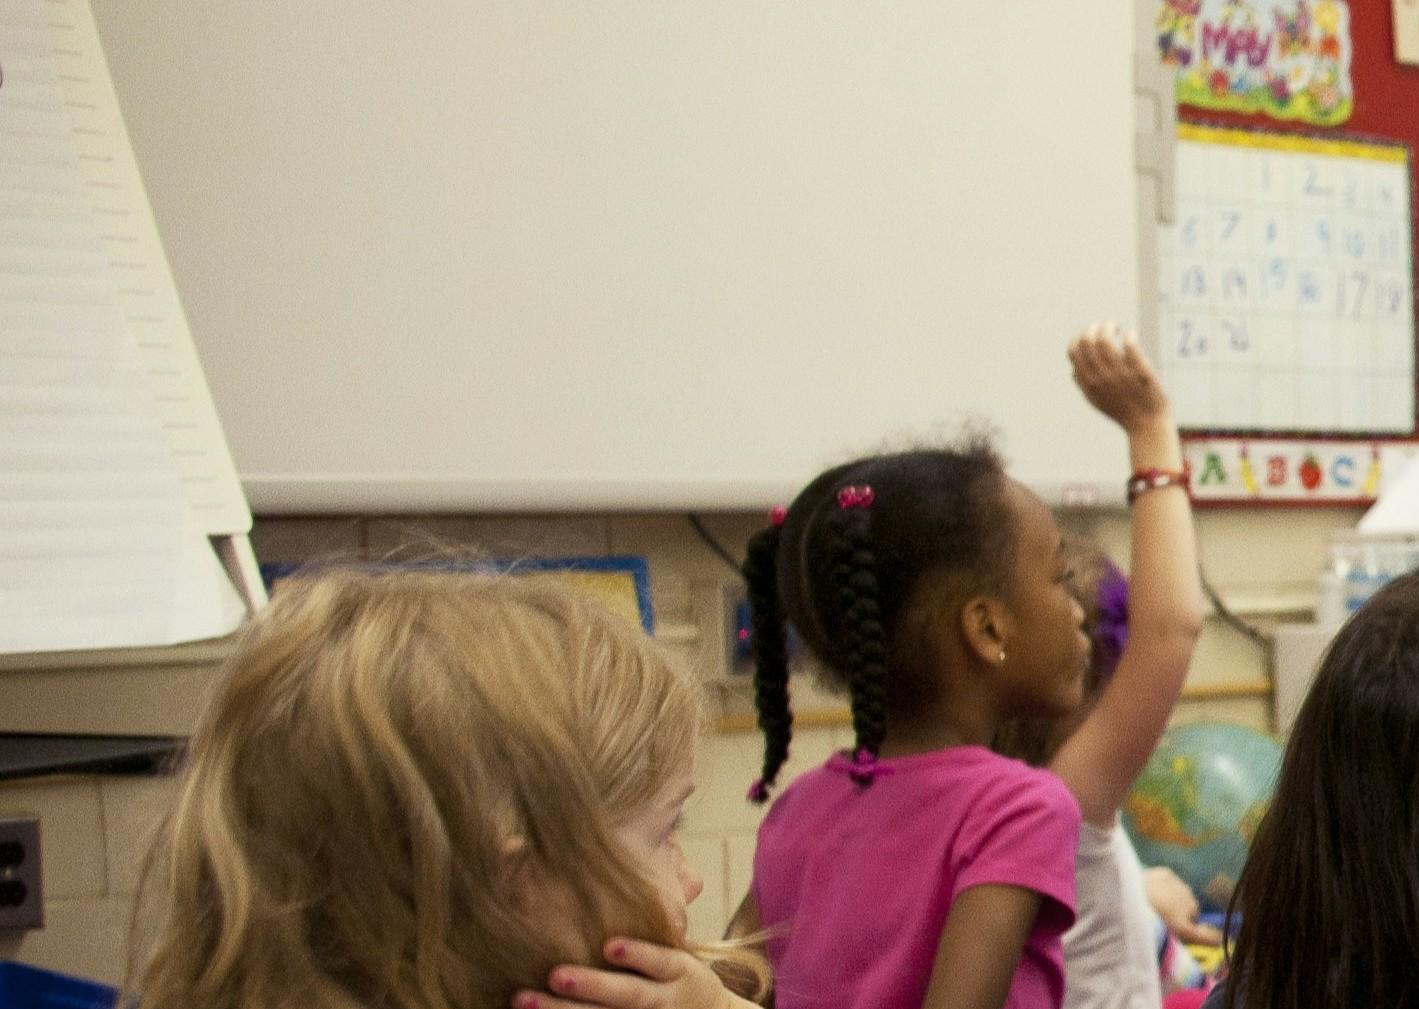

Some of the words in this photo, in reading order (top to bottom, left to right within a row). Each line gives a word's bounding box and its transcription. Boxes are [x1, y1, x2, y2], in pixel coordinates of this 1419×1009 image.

[1303, 161, 1333, 196] 2
[1335, 270, 1372, 322] 17
[1196, 451, 1228, 485] A
[1266, 456, 1288, 486] B
[1330, 456, 1357, 486] C
